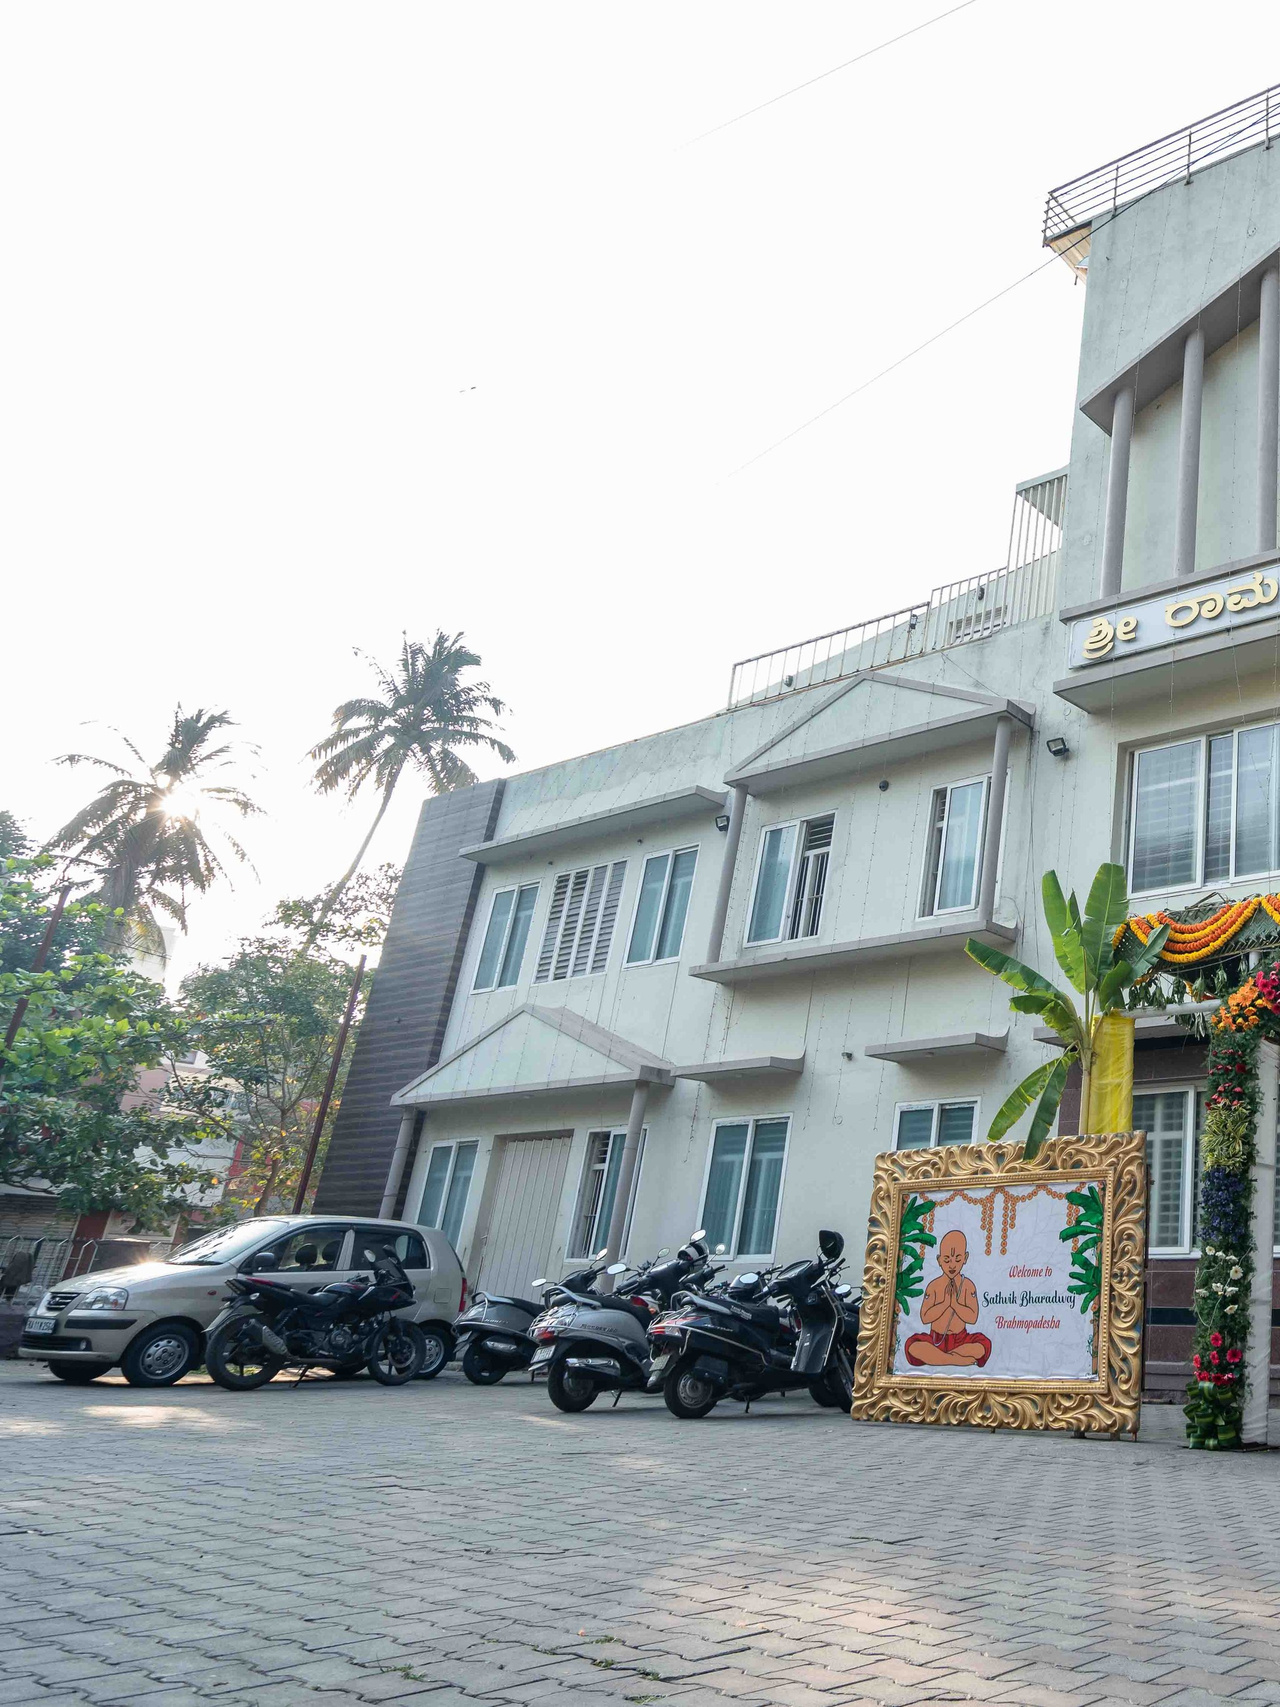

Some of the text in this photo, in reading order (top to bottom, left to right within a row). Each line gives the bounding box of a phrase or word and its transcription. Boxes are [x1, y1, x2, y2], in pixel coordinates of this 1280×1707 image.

[1082, 615, 1138, 659] ಶ್ರೀ
[1165, 571, 1279, 628] ರಾಮ
[1009, 1264, 1053, 1278] Welcome to
[982, 1290, 1076, 1309] Sathvik Bharadwaj
[995, 1315, 1061, 1334] Brahmopadesha
